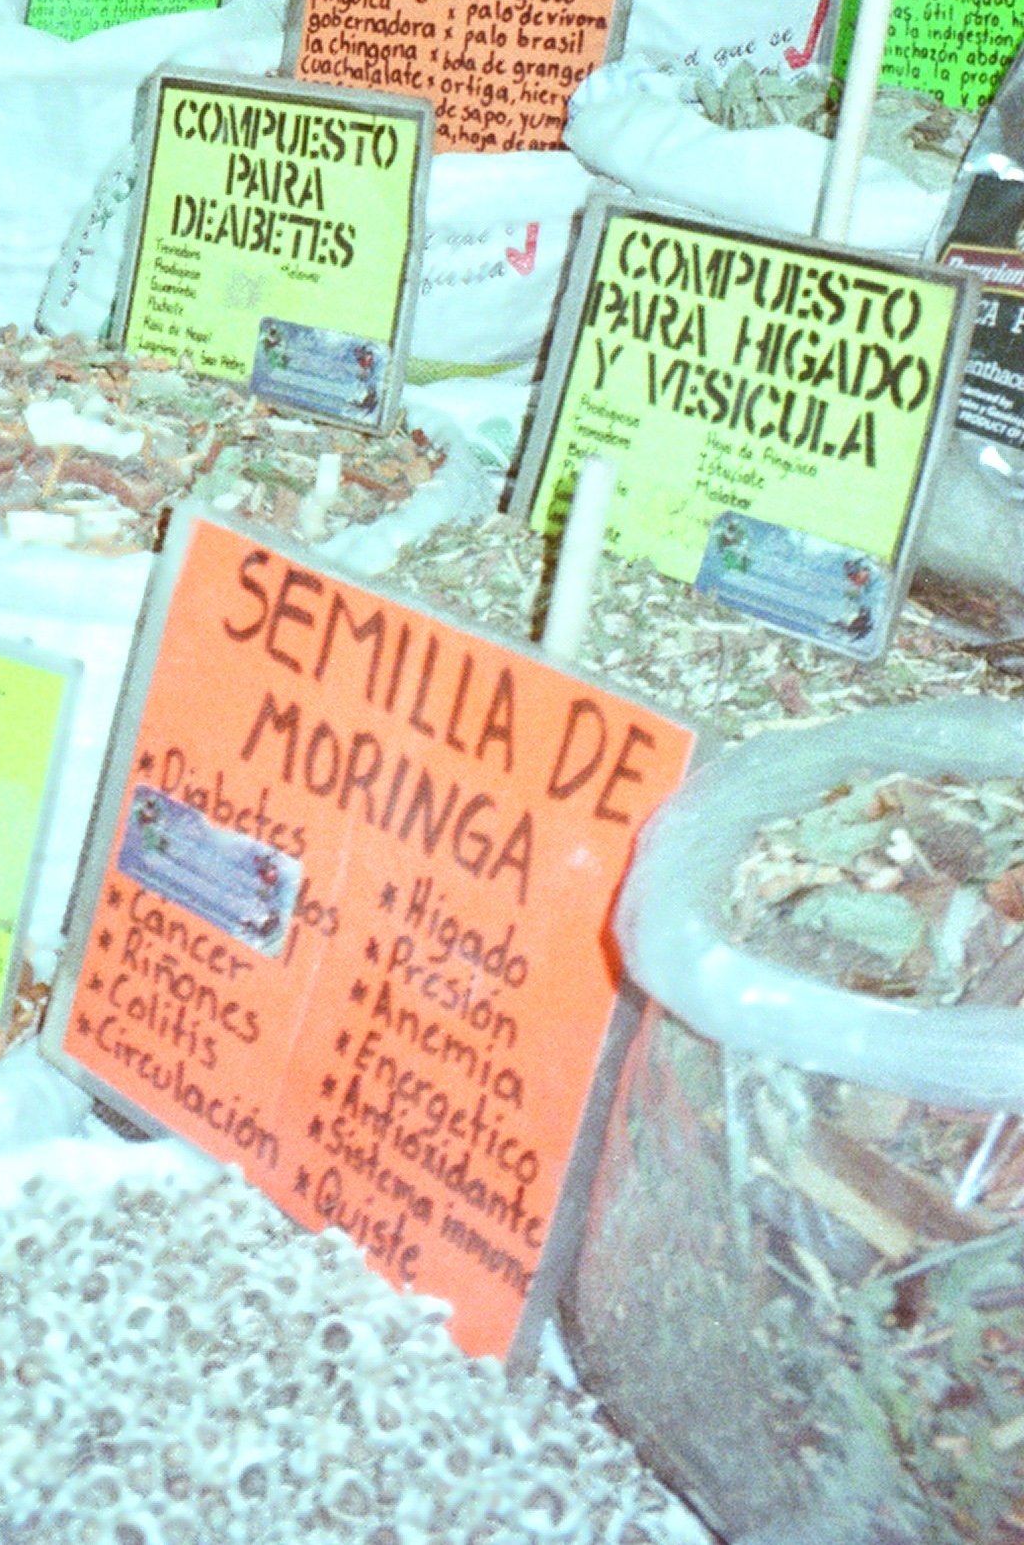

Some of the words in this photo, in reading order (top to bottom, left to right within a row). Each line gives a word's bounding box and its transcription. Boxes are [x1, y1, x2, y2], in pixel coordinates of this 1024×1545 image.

[305, 33, 323, 54] la
[307, 6, 436, 39] gobernadora
[464, 24, 507, 53] palo
[517, 27, 584, 54] brasil
[467, 0, 513, 25] palo
[482, 51, 507, 75] de
[934, 59, 950, 81] la
[960, 70, 1002, 91] prod
[174, 99, 398, 170] COMPUESTO
[435, 97, 457, 118] de
[459, 125, 497, 152] hoja
[502, 131, 525, 151] de
[225, 153, 324, 211] PARA
[619, 230, 921, 342] COMPUESTO
[587, 281, 707, 357] PARA
[734, 315, 931, 413] HIGADO
[594, 338, 623, 390] Y
[648, 352, 877, 468] VESICULA
[222, 548, 516, 774] SEMILLA
[548, 698, 656, 824] DE
[241, 692, 535, 906] MORINGA
[124, 927, 261, 1046] Riñones
[108, 973, 218, 1070] Colitis
[371, 980, 524, 1110] Anemia
[326, 1114, 435, 1225] Sistema
